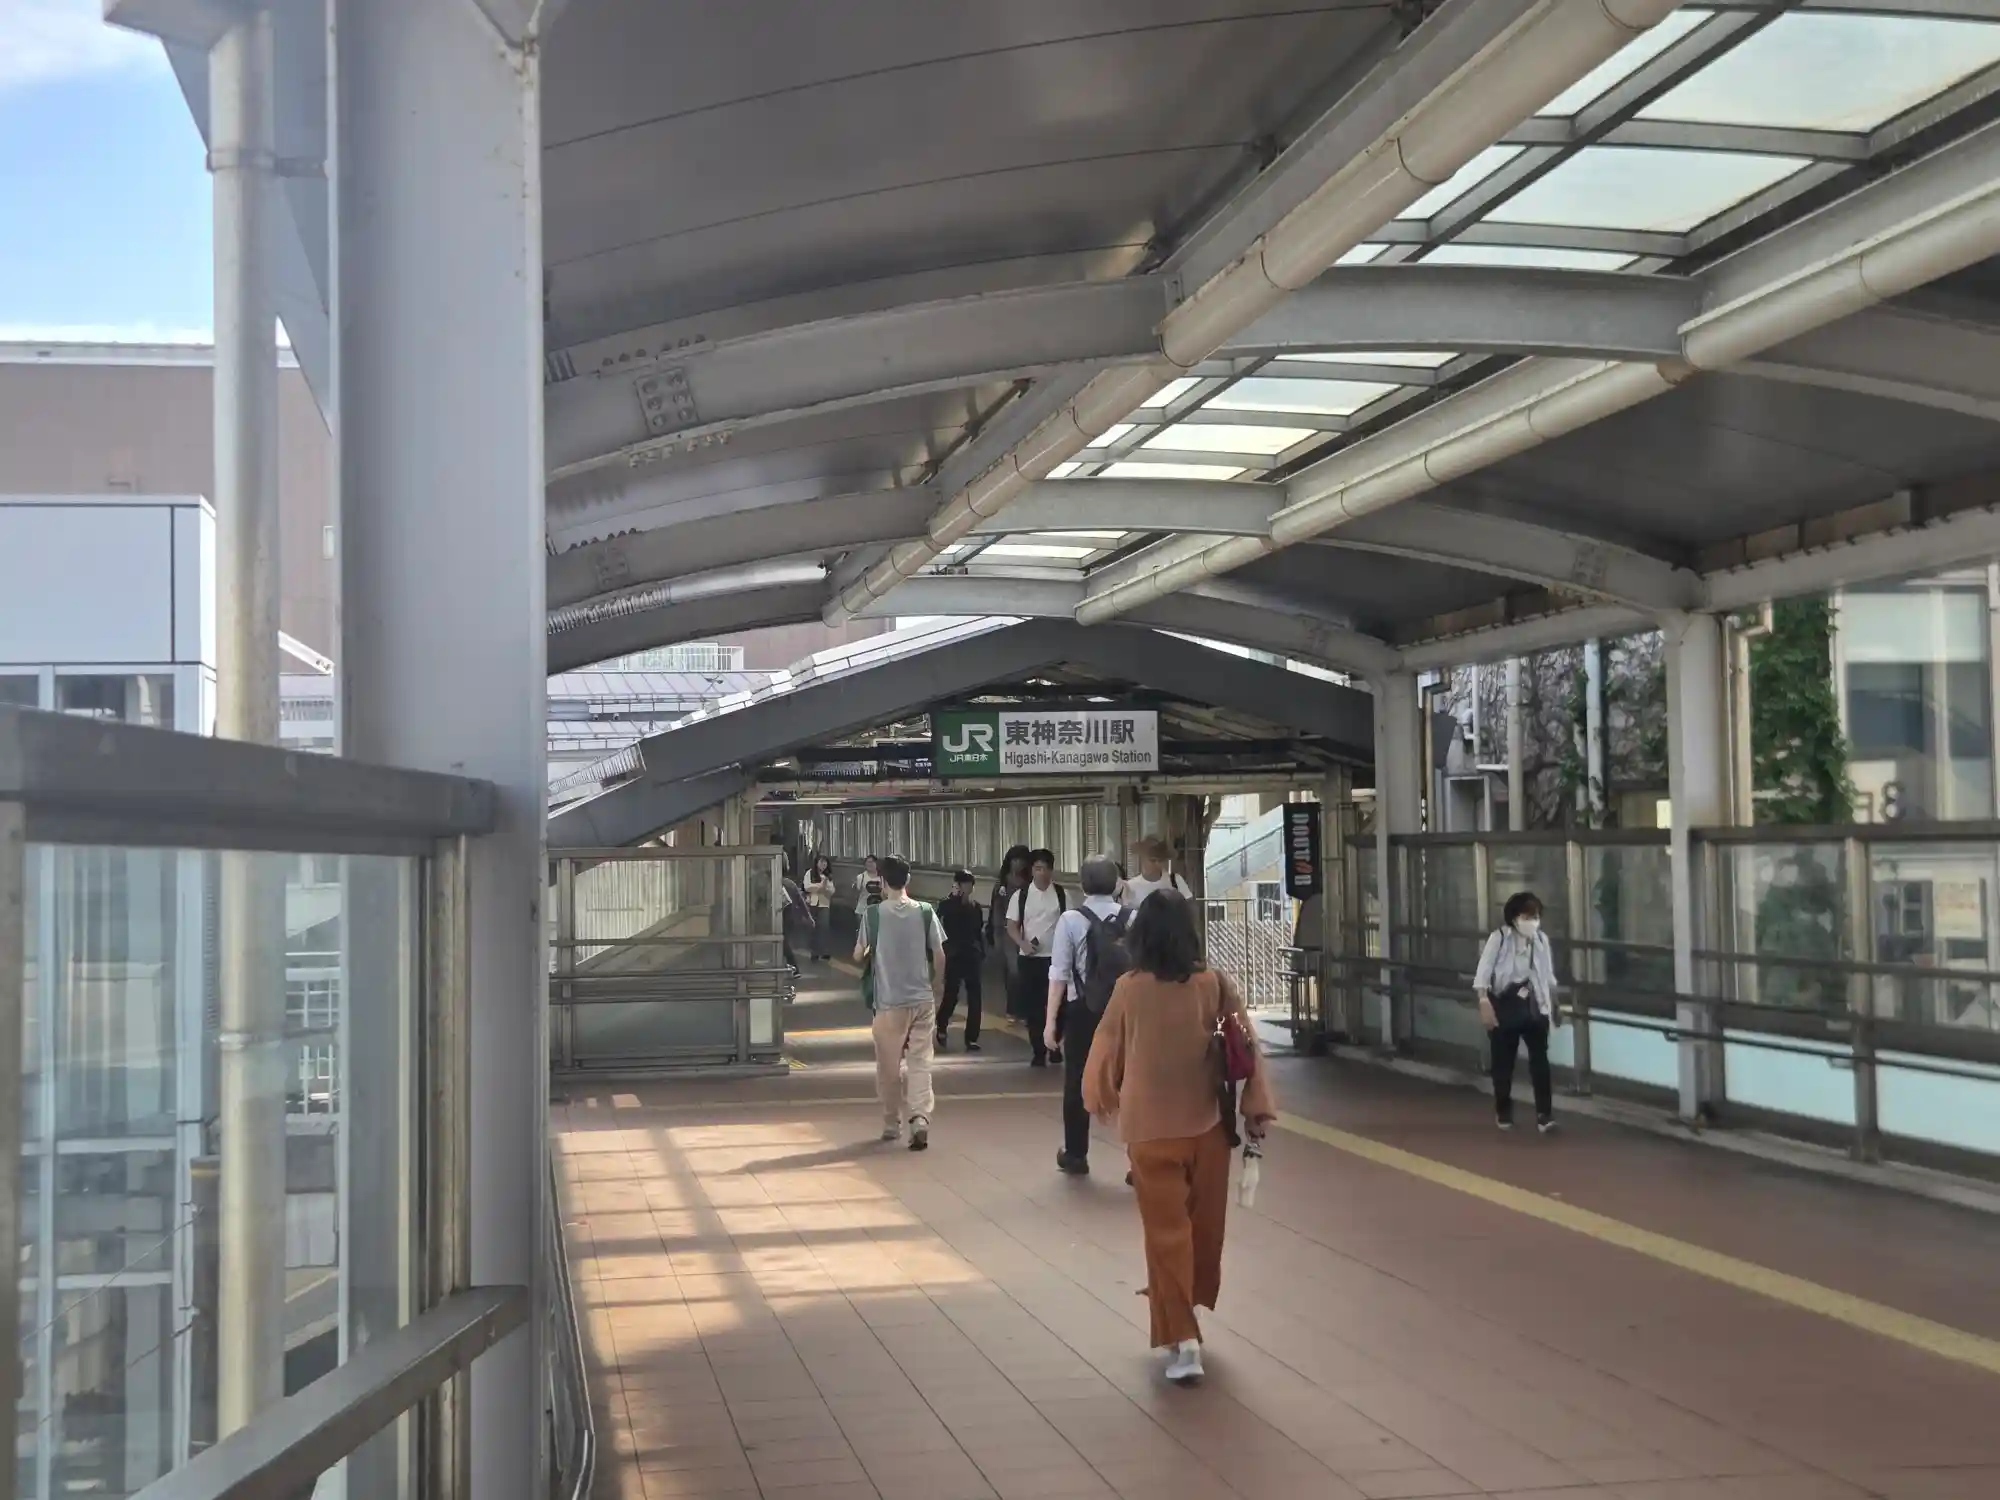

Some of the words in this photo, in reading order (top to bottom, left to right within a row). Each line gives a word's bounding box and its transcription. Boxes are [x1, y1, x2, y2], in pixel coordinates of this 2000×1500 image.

[942, 723, 993, 752] JR
[1005, 719, 1135, 745] 東神奈川駅
[1004, 750, 1109, 768] Higashi-Kanagawa
[1111, 749, 1152, 764] Station
